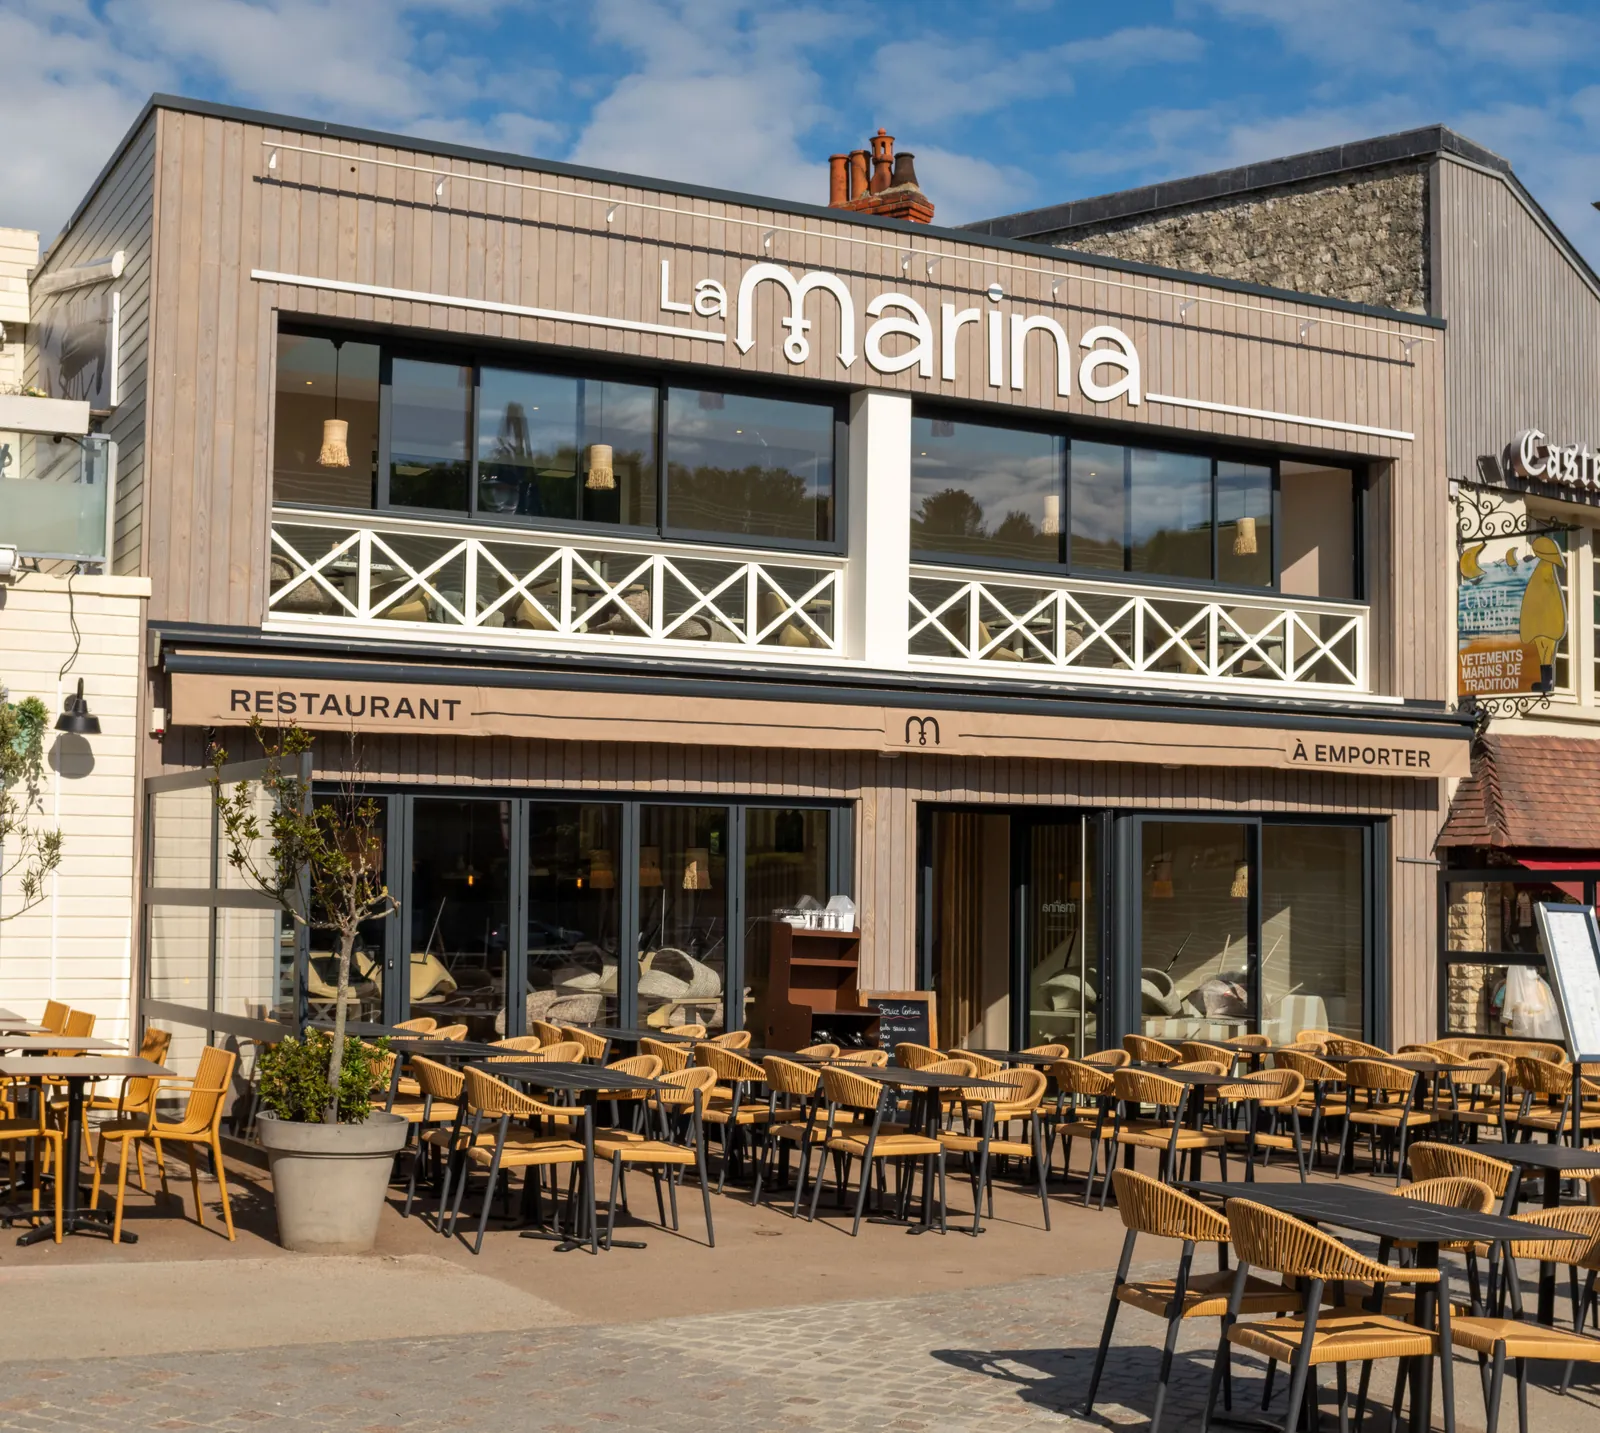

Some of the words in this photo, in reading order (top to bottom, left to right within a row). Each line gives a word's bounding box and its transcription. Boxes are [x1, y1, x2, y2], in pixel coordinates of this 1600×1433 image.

[660, 259, 728, 318] La
[1460, 649, 1523, 666] VETEMENTS
[1462, 664, 1502, 679] MARINS
[1507, 663, 1521, 675] DE
[1464, 678, 1519, 691] TRADITION
[230, 689, 462, 721] RESTAURANT
[1292, 738, 1308, 761] À
[1315, 744, 1431, 768] EMPORTER
